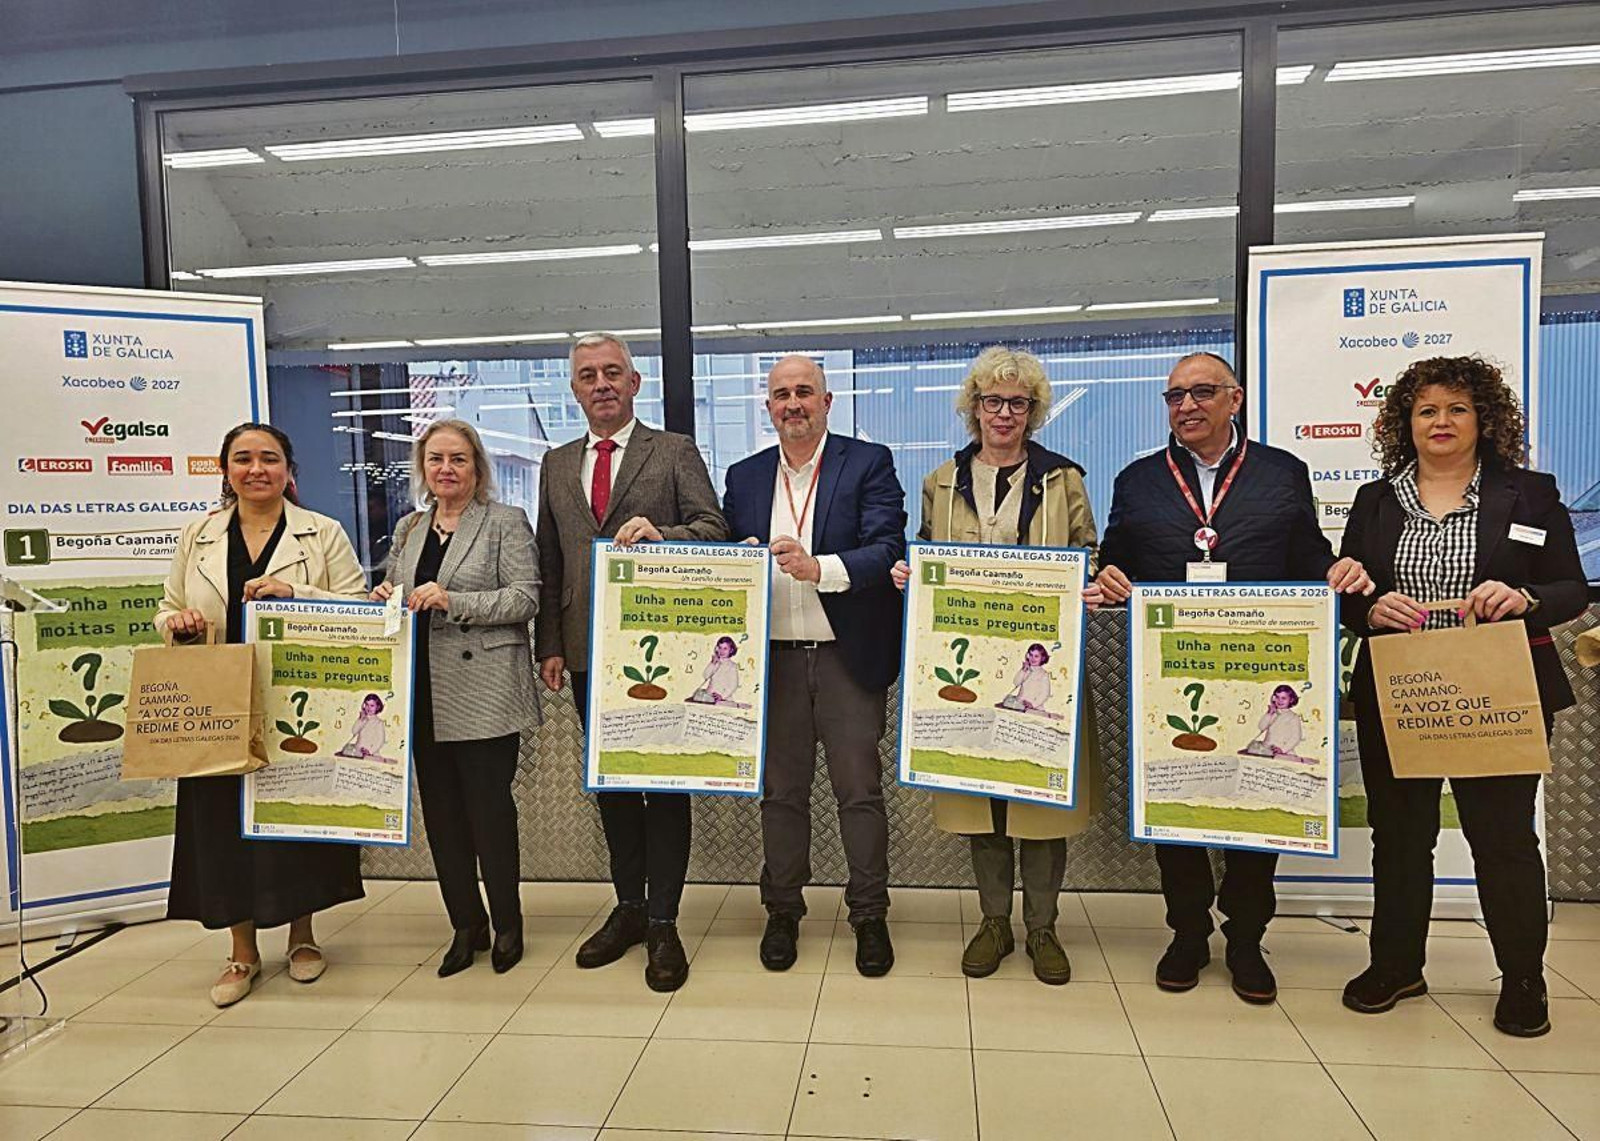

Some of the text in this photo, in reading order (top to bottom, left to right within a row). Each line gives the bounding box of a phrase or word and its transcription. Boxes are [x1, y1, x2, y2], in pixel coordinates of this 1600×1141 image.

[1369, 288, 1418, 300] XUNTA
[1369, 300, 1448, 314] DE GALICIA
[92, 334, 143, 346] XUNTA
[1339, 333, 1453, 349] Xacobeo 2027
[92, 346, 174, 360] DE GALICIA
[61, 376, 180, 390] Xacobeo 2027
[81, 416, 169, 441] Vegalsa
[1314, 426, 1360, 436] EROSKI
[40, 460, 90, 471] EROSKI
[190, 460, 216, 468] cash
[1313, 470, 1340, 481] DAS
[8, 504, 36, 514] DIA
[40, 504, 72, 513] DAS
[77, 502, 135, 513] LETRAS
[139, 501, 207, 512] GALEGAS
[1325, 505, 1350, 518] Beg
[18, 534, 36, 560] 1
[56, 535, 112, 549] Begoña
[132, 546, 146, 556] Un
[606, 544, 764, 558] DIA DAS LETRAS GALEGAS 2026
[918, 547, 1080, 562] DIA DAS LETRAS GALEGAS 2026
[616, 563, 626, 580] 1
[638, 565, 712, 575] Begoña Caamaño
[928, 566, 938, 582] 1
[949, 568, 1024, 579] Begoña Caamaño
[1025, 580, 1034, 588] de
[1142, 588, 1329, 598] DIA DAS LETRAS GALEGAS 2026
[636, 594, 734, 607] Unha nena con
[947, 596, 1046, 614] Unha nena con
[256, 602, 384, 616] DIA DAS LETRAS GALEGAS
[1178, 608, 1264, 618] Begoña Caamaño
[623, 612, 744, 626] moitas preguntas
[935, 614, 1056, 632] moitas preguntas
[1155, 607, 1166, 626] 1
[41, 622, 156, 638] moitas pr
[266, 620, 276, 638] 1
[288, 623, 358, 634] Begoña Caamaño
[1177, 640, 1292, 652] Unha nena con
[286, 651, 379, 665] Unha nena con
[1164, 658, 1306, 674] moitas preguntas
[274, 668, 390, 684] moitas preguntas
[1390, 672, 1442, 686] BEGOÑA
[140, 680, 179, 694] BEGOÑA
[1391, 684, 1462, 699] CAAMAÑO:
[139, 692, 192, 706] CAAMAÑO:
[1416, 700, 1451, 713] VOZ
[1456, 696, 1492, 710] QUE
[154, 707, 180, 718] VOZ
[184, 706, 212, 717] QUE
[136, 722, 179, 734] REDIME
[184, 720, 195, 731] O
[1397, 716, 1455, 730] REDIME
[1460, 714, 1474, 726] O
[1434, 732, 1448, 740] DAS
[1450, 732, 1476, 740] LETRAS
[1478, 730, 1513, 738] GALEGAS
